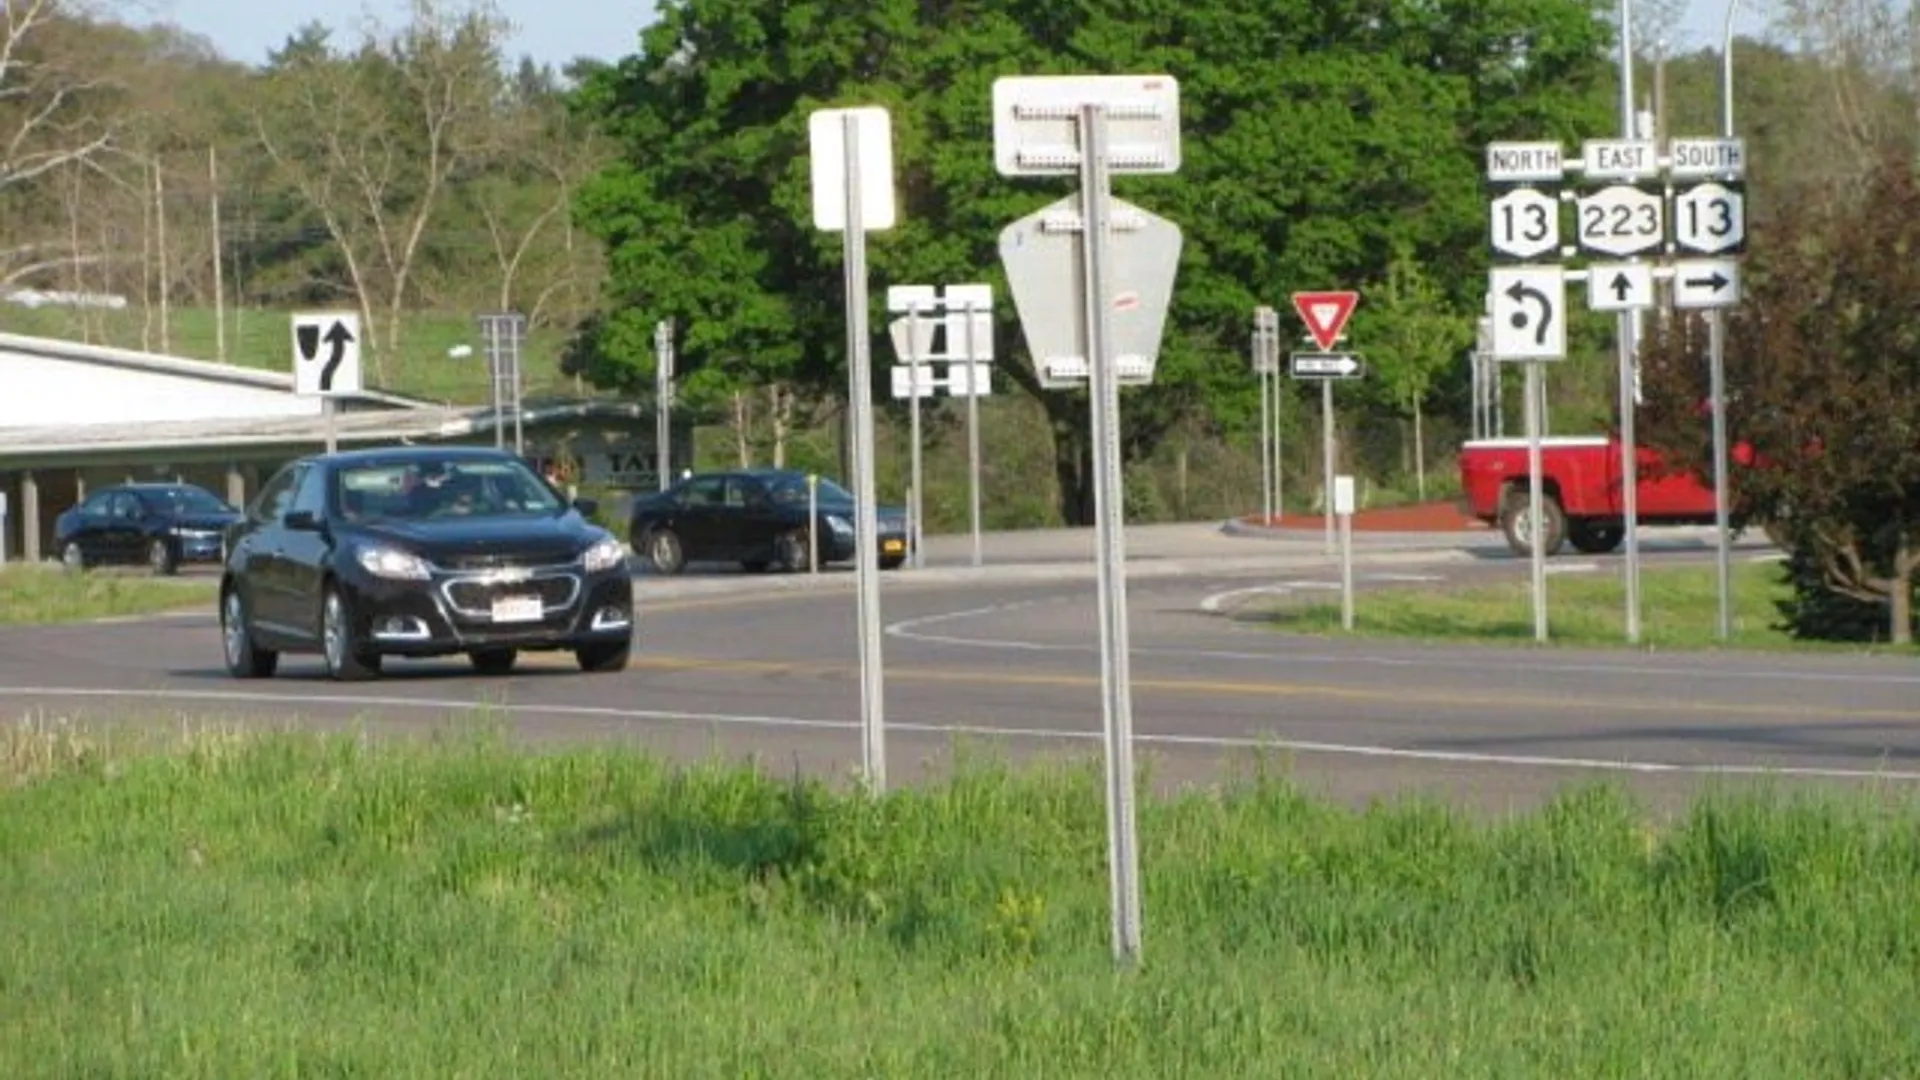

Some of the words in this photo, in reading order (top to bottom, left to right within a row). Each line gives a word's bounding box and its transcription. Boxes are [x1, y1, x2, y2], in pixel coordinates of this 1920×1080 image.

[1493, 151, 1559, 171] NORTH
[1598, 147, 1645, 168] EAST
[1676, 145, 1739, 165] SOUTH
[1502, 204, 1548, 242] 13
[1583, 204, 1658, 238] 223
[1687, 199, 1733, 237] 13
